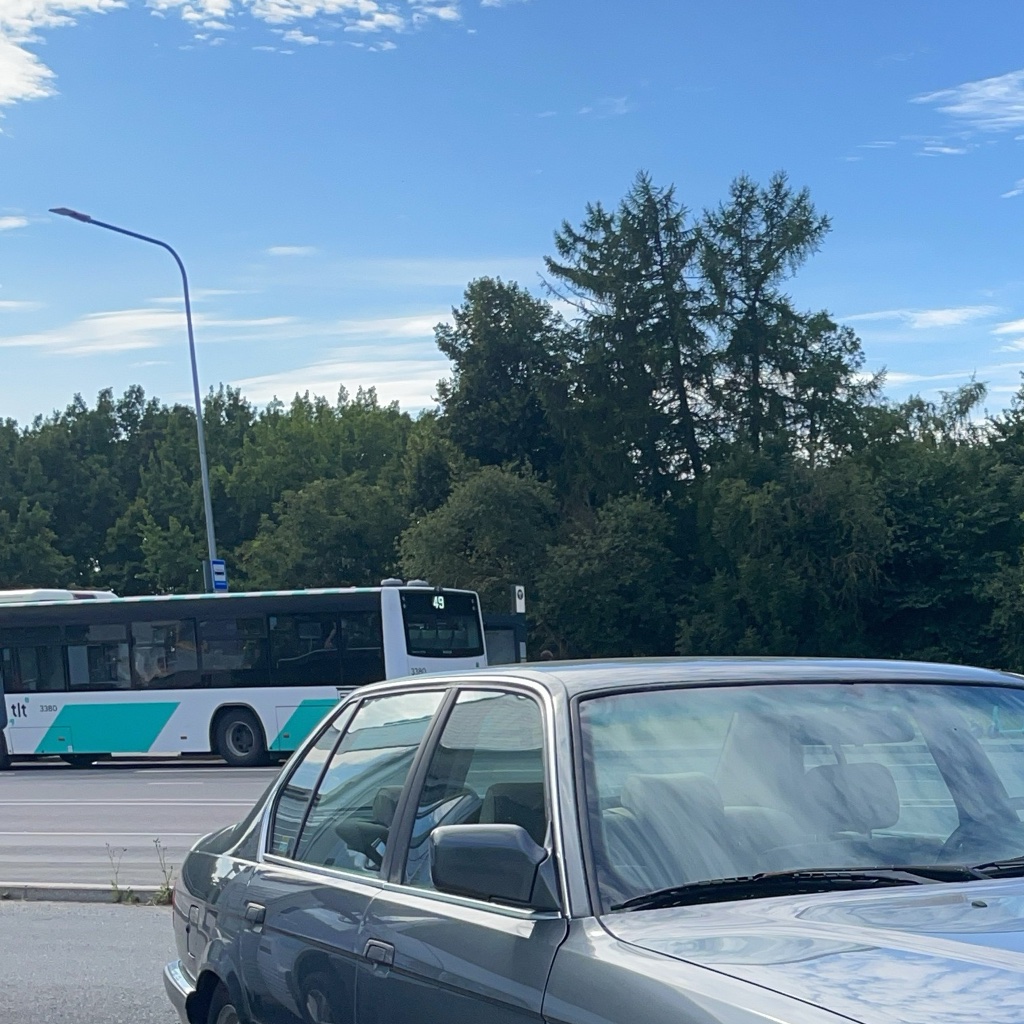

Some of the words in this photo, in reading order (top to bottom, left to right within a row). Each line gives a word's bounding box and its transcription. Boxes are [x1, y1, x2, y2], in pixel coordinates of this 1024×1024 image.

[432, 595, 445, 609] 49
[10, 702, 28, 718] tlt
[40, 704, 58, 712] 3380
